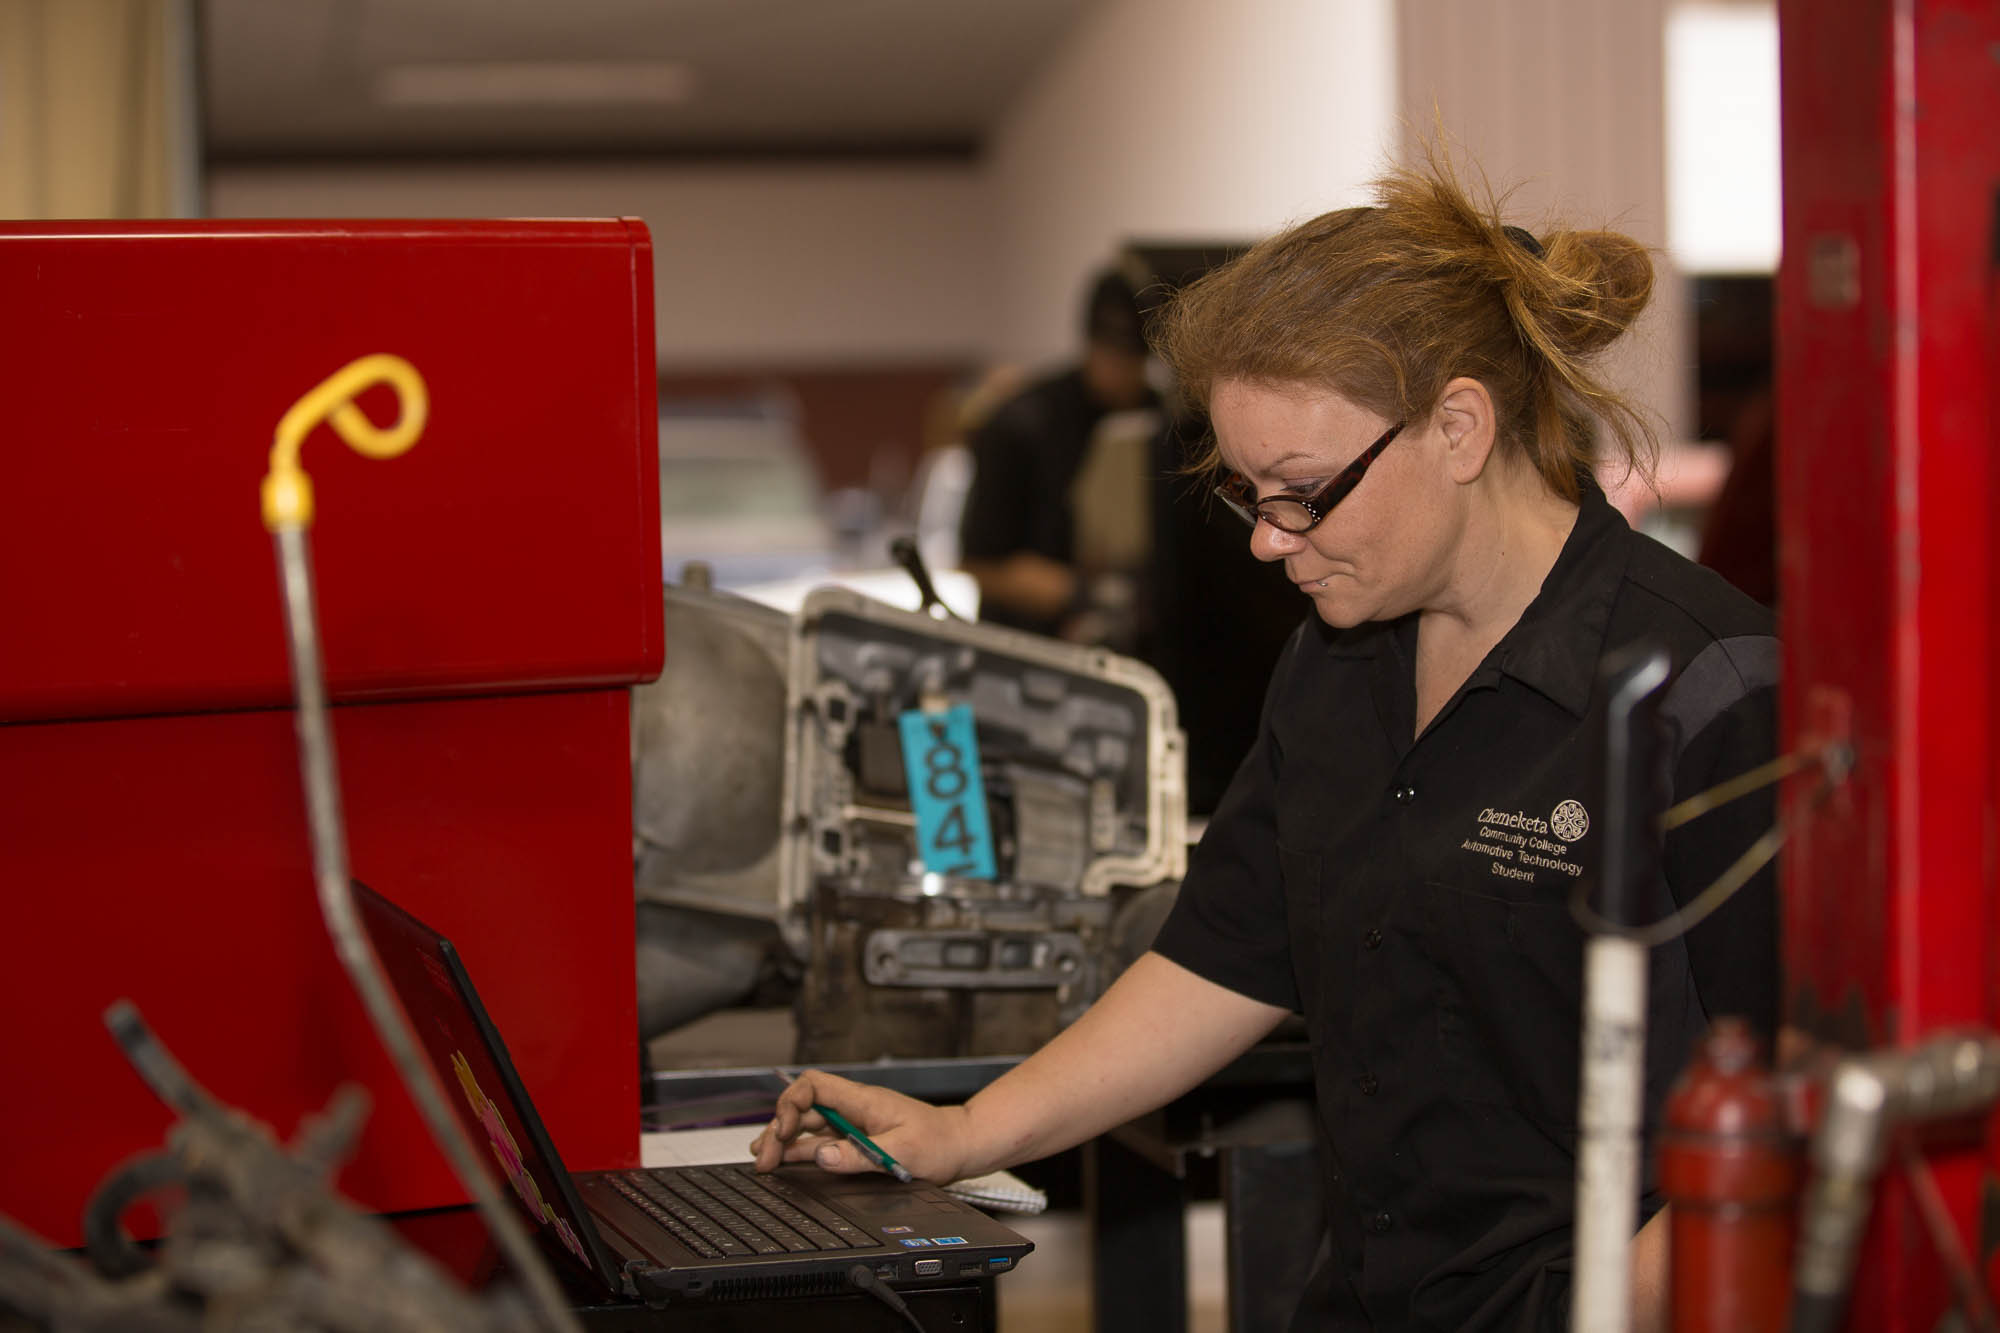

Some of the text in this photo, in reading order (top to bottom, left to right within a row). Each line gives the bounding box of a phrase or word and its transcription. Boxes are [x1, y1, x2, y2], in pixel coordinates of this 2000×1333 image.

[1478, 808, 1548, 834] Chemeketa
[1480, 826, 1568, 856] Community College
[1461, 840, 1583, 876] Automotive Technology
[1492, 862, 1535, 882] Student
